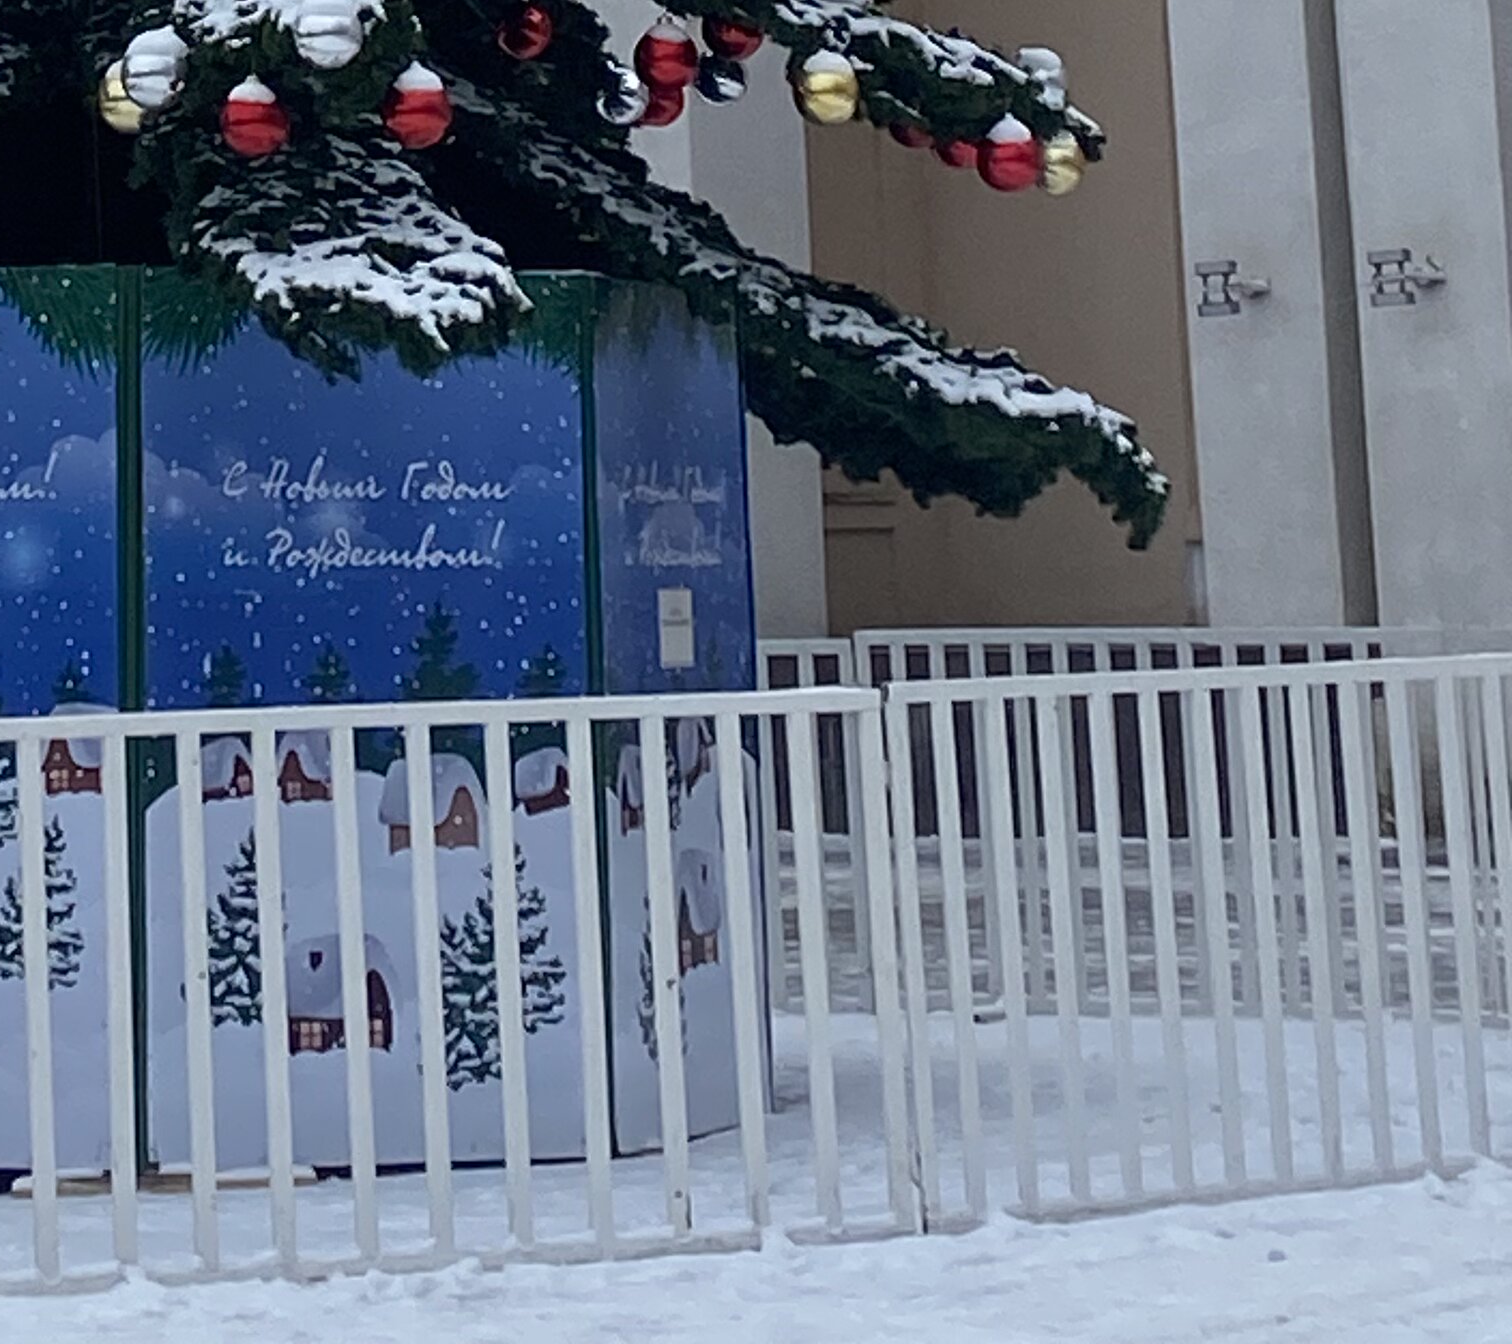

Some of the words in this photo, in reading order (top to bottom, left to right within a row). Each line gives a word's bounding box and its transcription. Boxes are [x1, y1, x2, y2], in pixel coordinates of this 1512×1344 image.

[223, 461, 248, 496] С
[260, 456, 387, 502] Новым
[401, 461, 514, 500] Годом
[223, 543, 250, 566] и
[265, 518, 506, 578] Рождеством!
